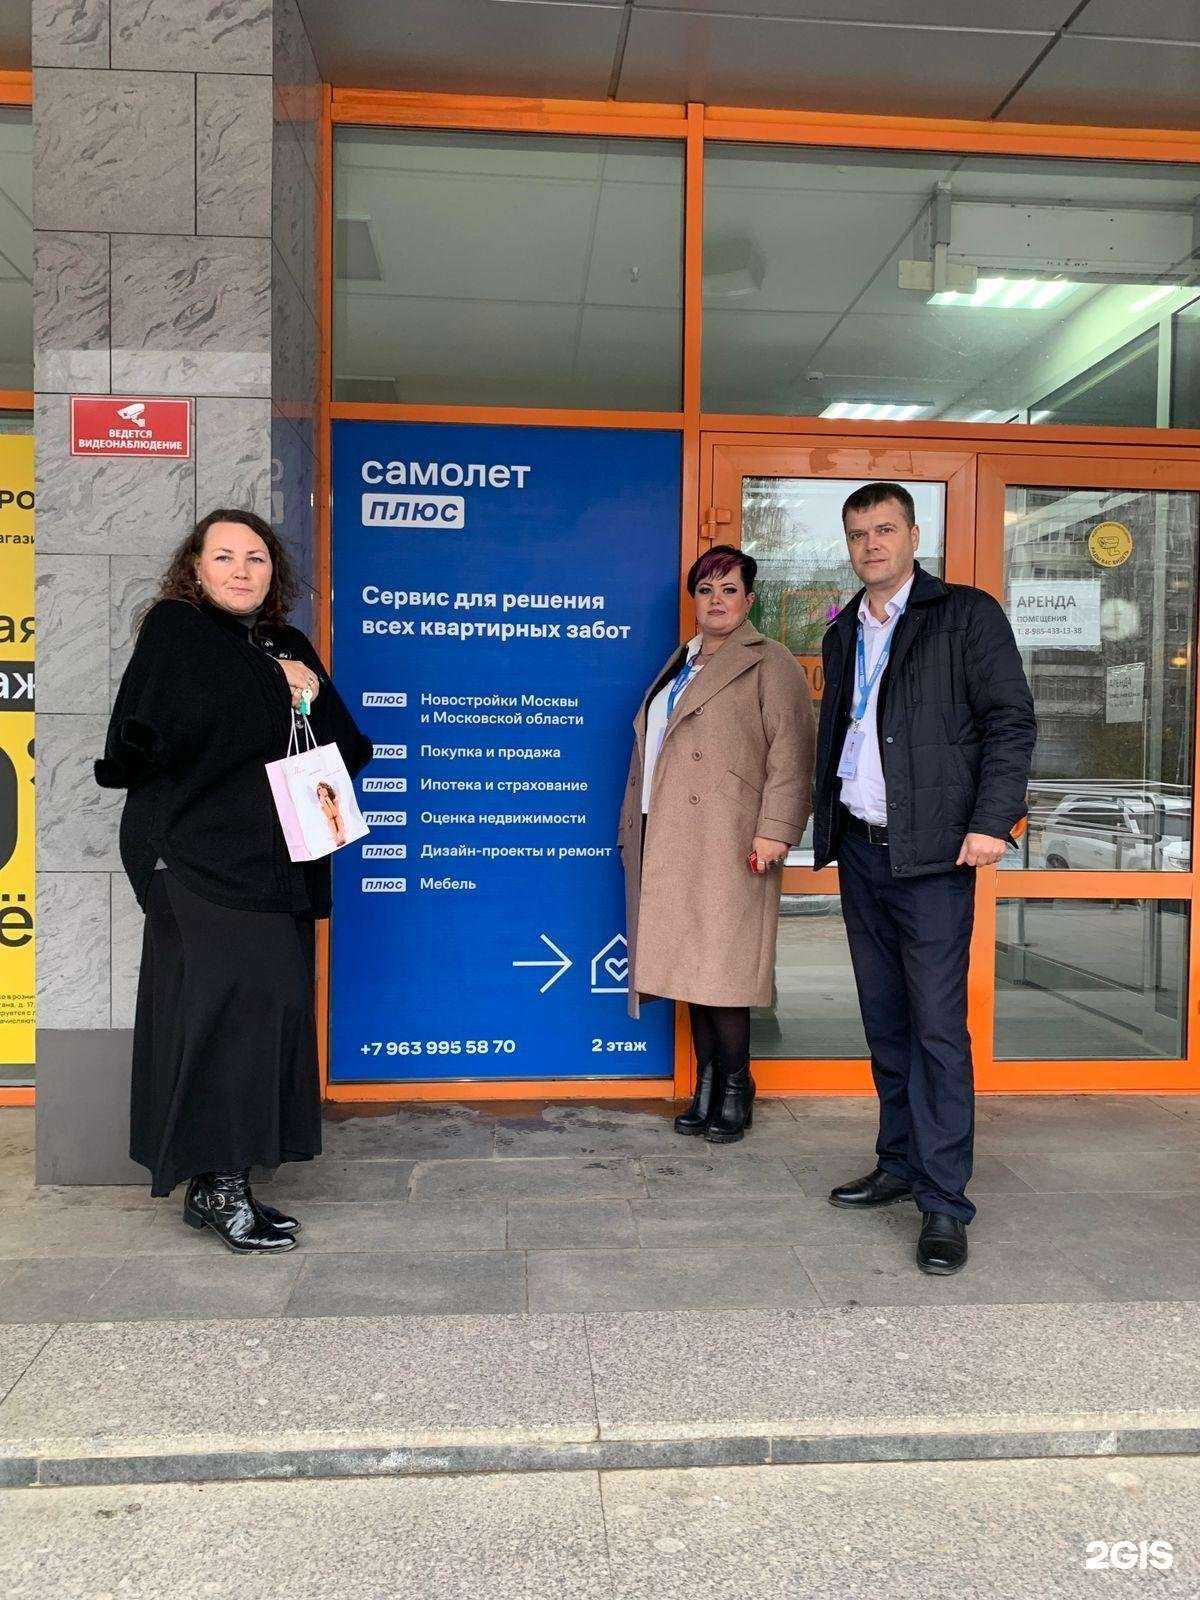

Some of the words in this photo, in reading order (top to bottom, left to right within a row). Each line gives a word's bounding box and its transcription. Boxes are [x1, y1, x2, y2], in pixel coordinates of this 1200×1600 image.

[108, 429, 153, 440] ВЕДЕТСЯ
[78, 438, 183, 451] ВИДЕОНАБЛЮДЕНИЕ
[361, 460, 531, 489] самолет
[369, 500, 460, 523] плюс
[362, 585, 450, 610] Сервис
[453, 592, 497, 610] для
[502, 593, 605, 613] решения
[1016, 595, 1077, 610] АРЕНДА
[1016, 615, 1068, 624] ПОМЕЩЕНИЯ
[362, 620, 415, 635] всех
[420, 621, 561, 642] квартирных
[566, 620, 631, 639] забот
[365, 695, 404, 705] плюс
[421, 693, 518, 709] Новостройки
[521, 694, 579, 707] Москвы
[420, 714, 430, 723] и
[433, 711, 523, 725] Московской
[525, 712, 584, 725] области
[374, 747, 404, 756] люс
[420, 744, 483, 760] Покупка
[485, 748, 495, 758] и
[498, 748, 561, 761] продажа
[365, 781, 404, 790] плюс
[420, 778, 482, 791] Ипотека
[485, 781, 494, 791] и
[497, 781, 588, 794] страхование
[365, 814, 404, 823] плюс
[420, 811, 476, 826] Оценка
[478, 814, 586, 826] недвижимости
[365, 847, 403, 856] плюс
[420, 844, 544, 859] Дизайн-проекты
[546, 847, 556, 857] и
[558, 847, 612, 860] ремонт
[364, 880, 403, 890] плюс
[420, 877, 477, 890] Мебель
[360, 1042, 383, 1056] +7
[385, 1041, 422, 1056] 963
[425, 1040, 462, 1055] 995
[465, 1039, 489, 1055] 58
[492, 1039, 516, 1054] 70
[591, 1038, 603, 1052] 2
[606, 1041, 647, 1052] этаж
